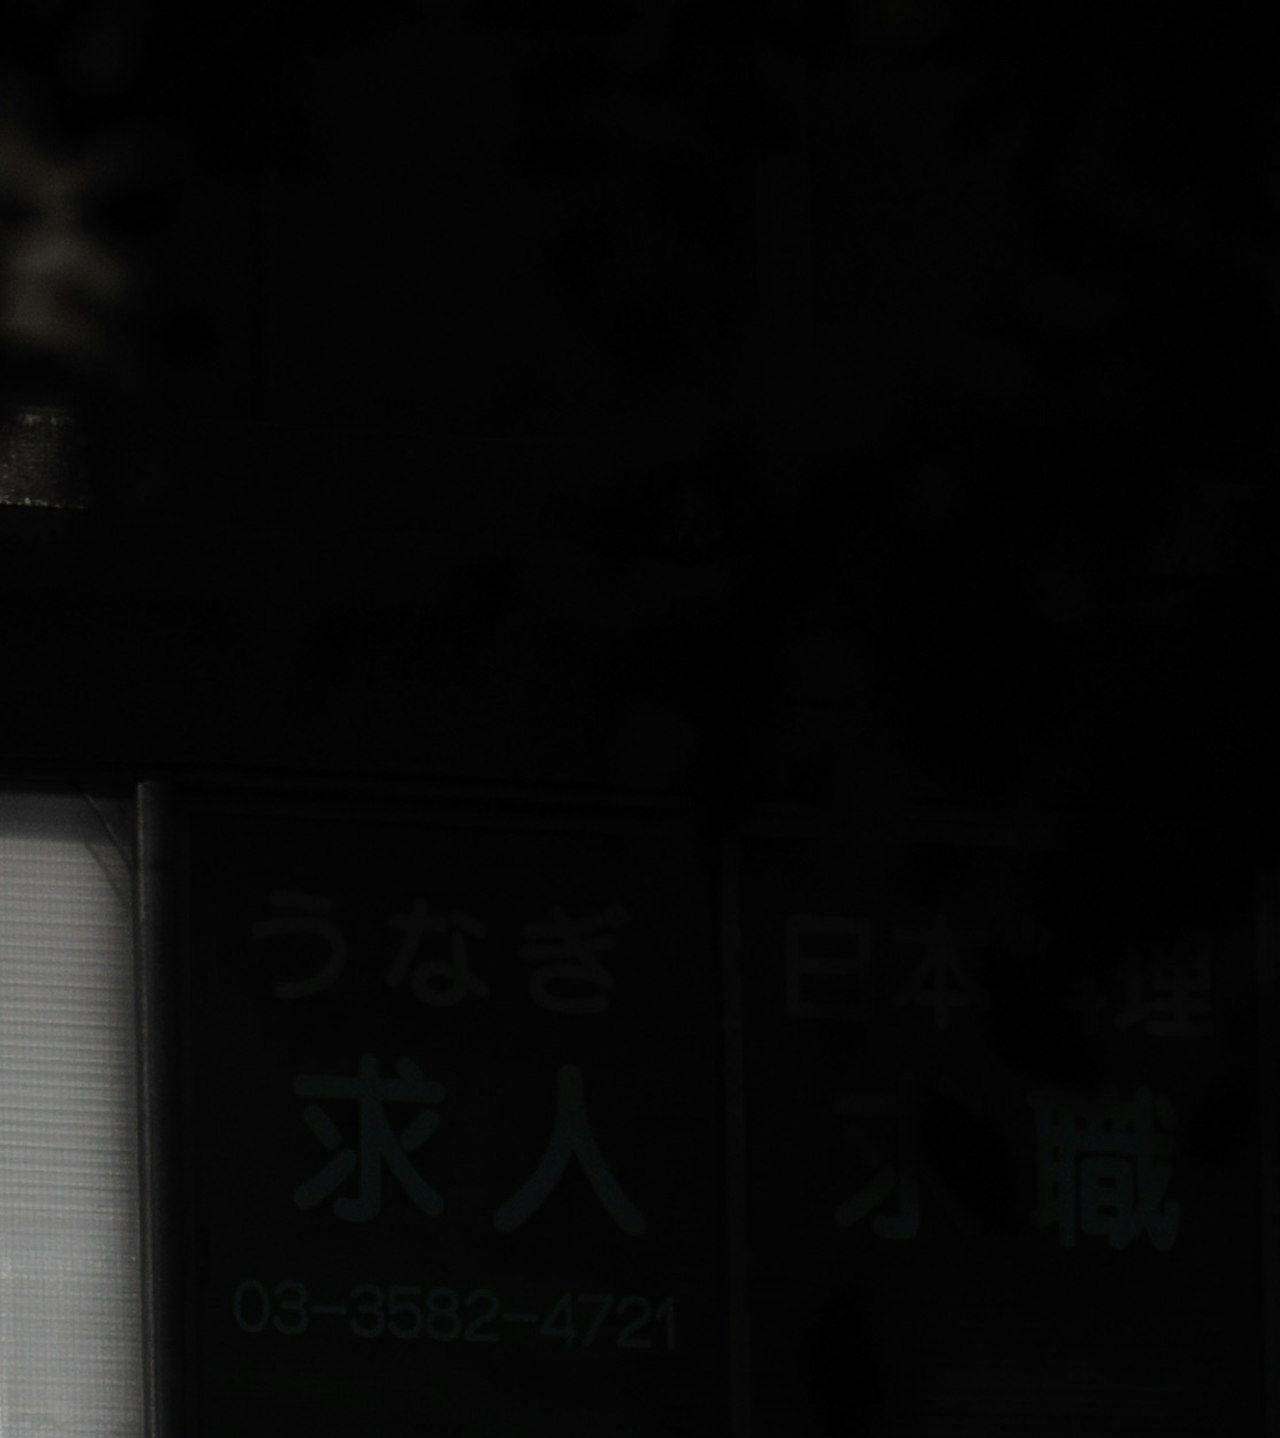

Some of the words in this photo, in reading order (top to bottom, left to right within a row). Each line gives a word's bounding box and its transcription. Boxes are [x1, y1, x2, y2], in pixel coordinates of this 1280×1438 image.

[252, 889, 633, 1014] うなぎ
[784, 913, 1216, 1038] 日本理
[292, 1052, 648, 1237] 求人
[233, 1280, 680, 1350] 03-3582-4721
